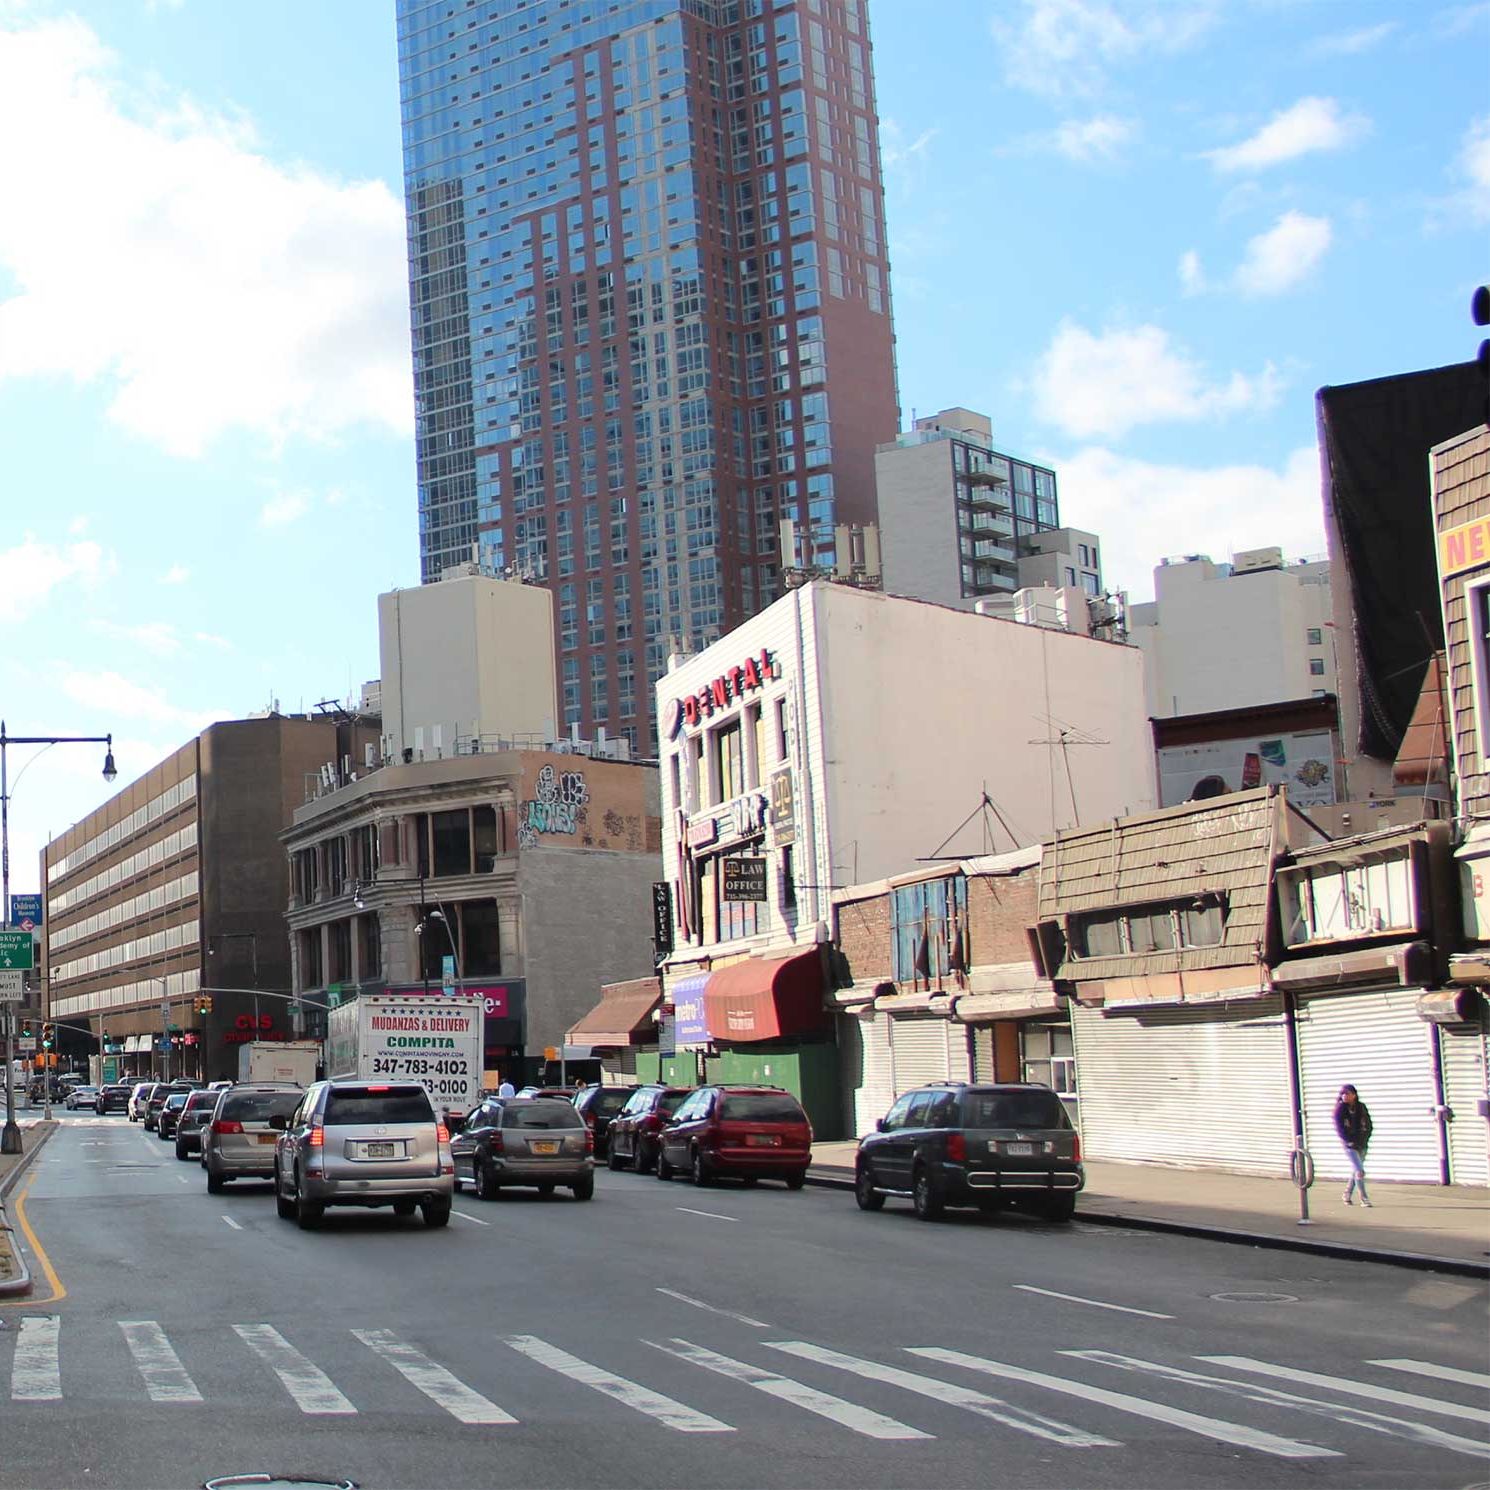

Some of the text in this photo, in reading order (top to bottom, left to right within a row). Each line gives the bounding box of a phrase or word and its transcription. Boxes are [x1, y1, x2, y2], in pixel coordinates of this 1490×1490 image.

[1446, 522, 1490, 569] NE
[684, 648, 773, 725] DENTAL
[741, 864, 764, 875] LAW
[726, 880, 764, 890] OFFICE
[13, 902, 39, 910] Children's
[657, 884, 667, 942] LAW OFFICE
[371, 1016, 470, 1032] MUDANZAS & DELIVERY
[387, 1036, 455, 1048] COMPITA
[373, 1058, 468, 1075] 347-783-4102
